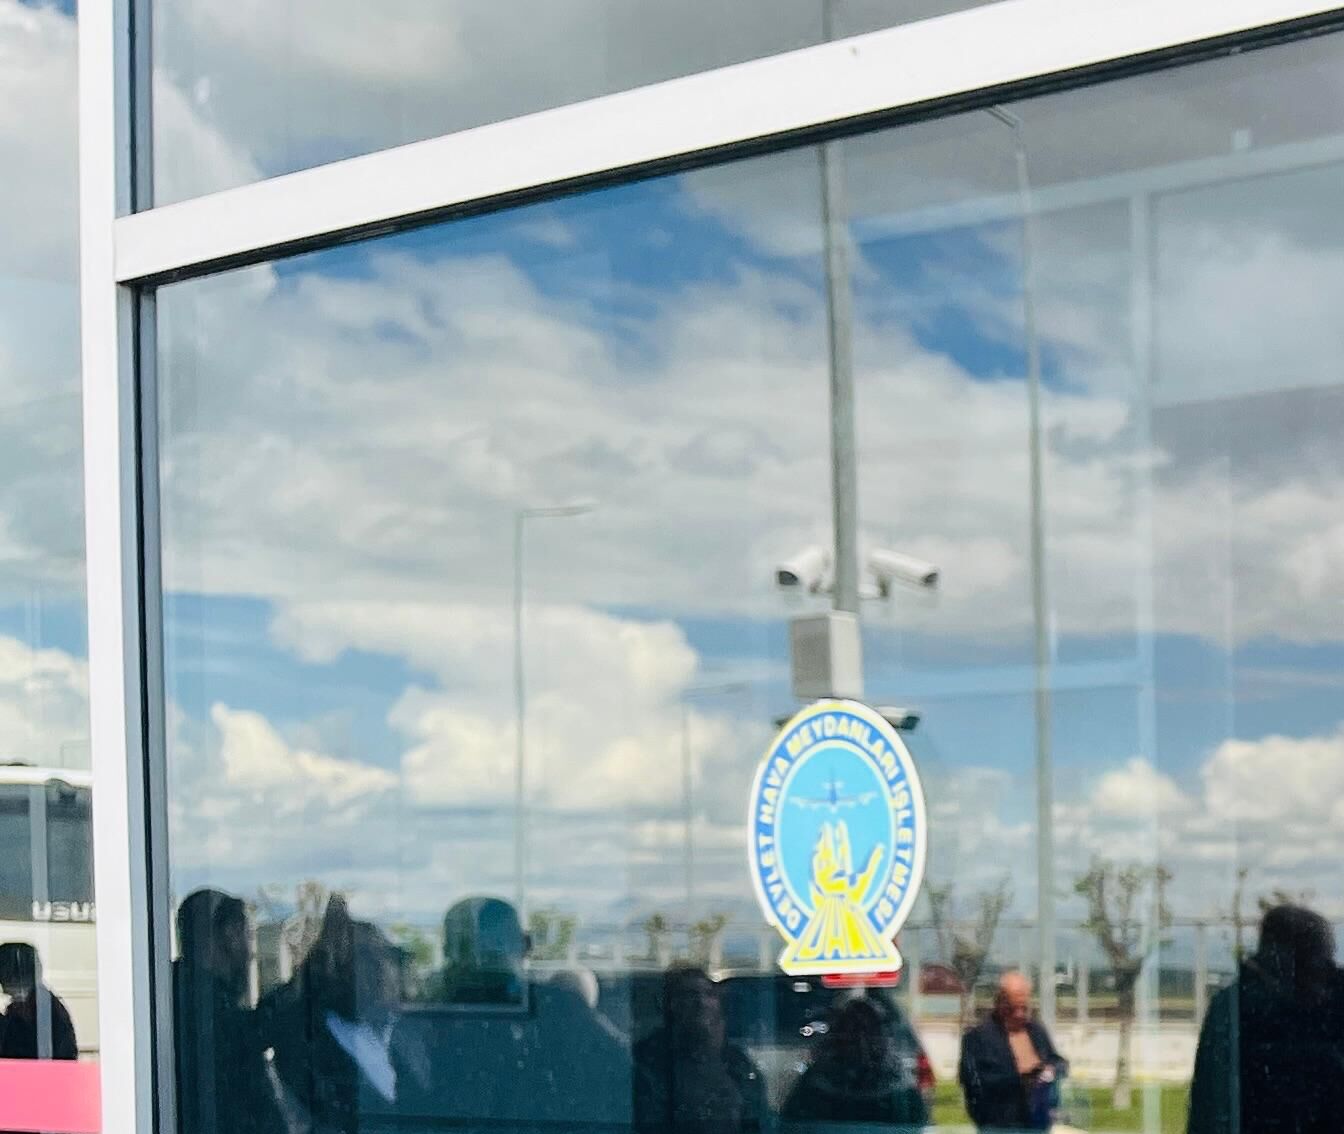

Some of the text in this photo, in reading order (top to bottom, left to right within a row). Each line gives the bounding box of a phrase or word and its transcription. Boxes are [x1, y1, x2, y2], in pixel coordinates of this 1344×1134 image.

[786, 714, 901, 781] MEYDANLARI
[759, 755, 790, 823] HAVA
[758, 832, 802, 930] DEVLET
